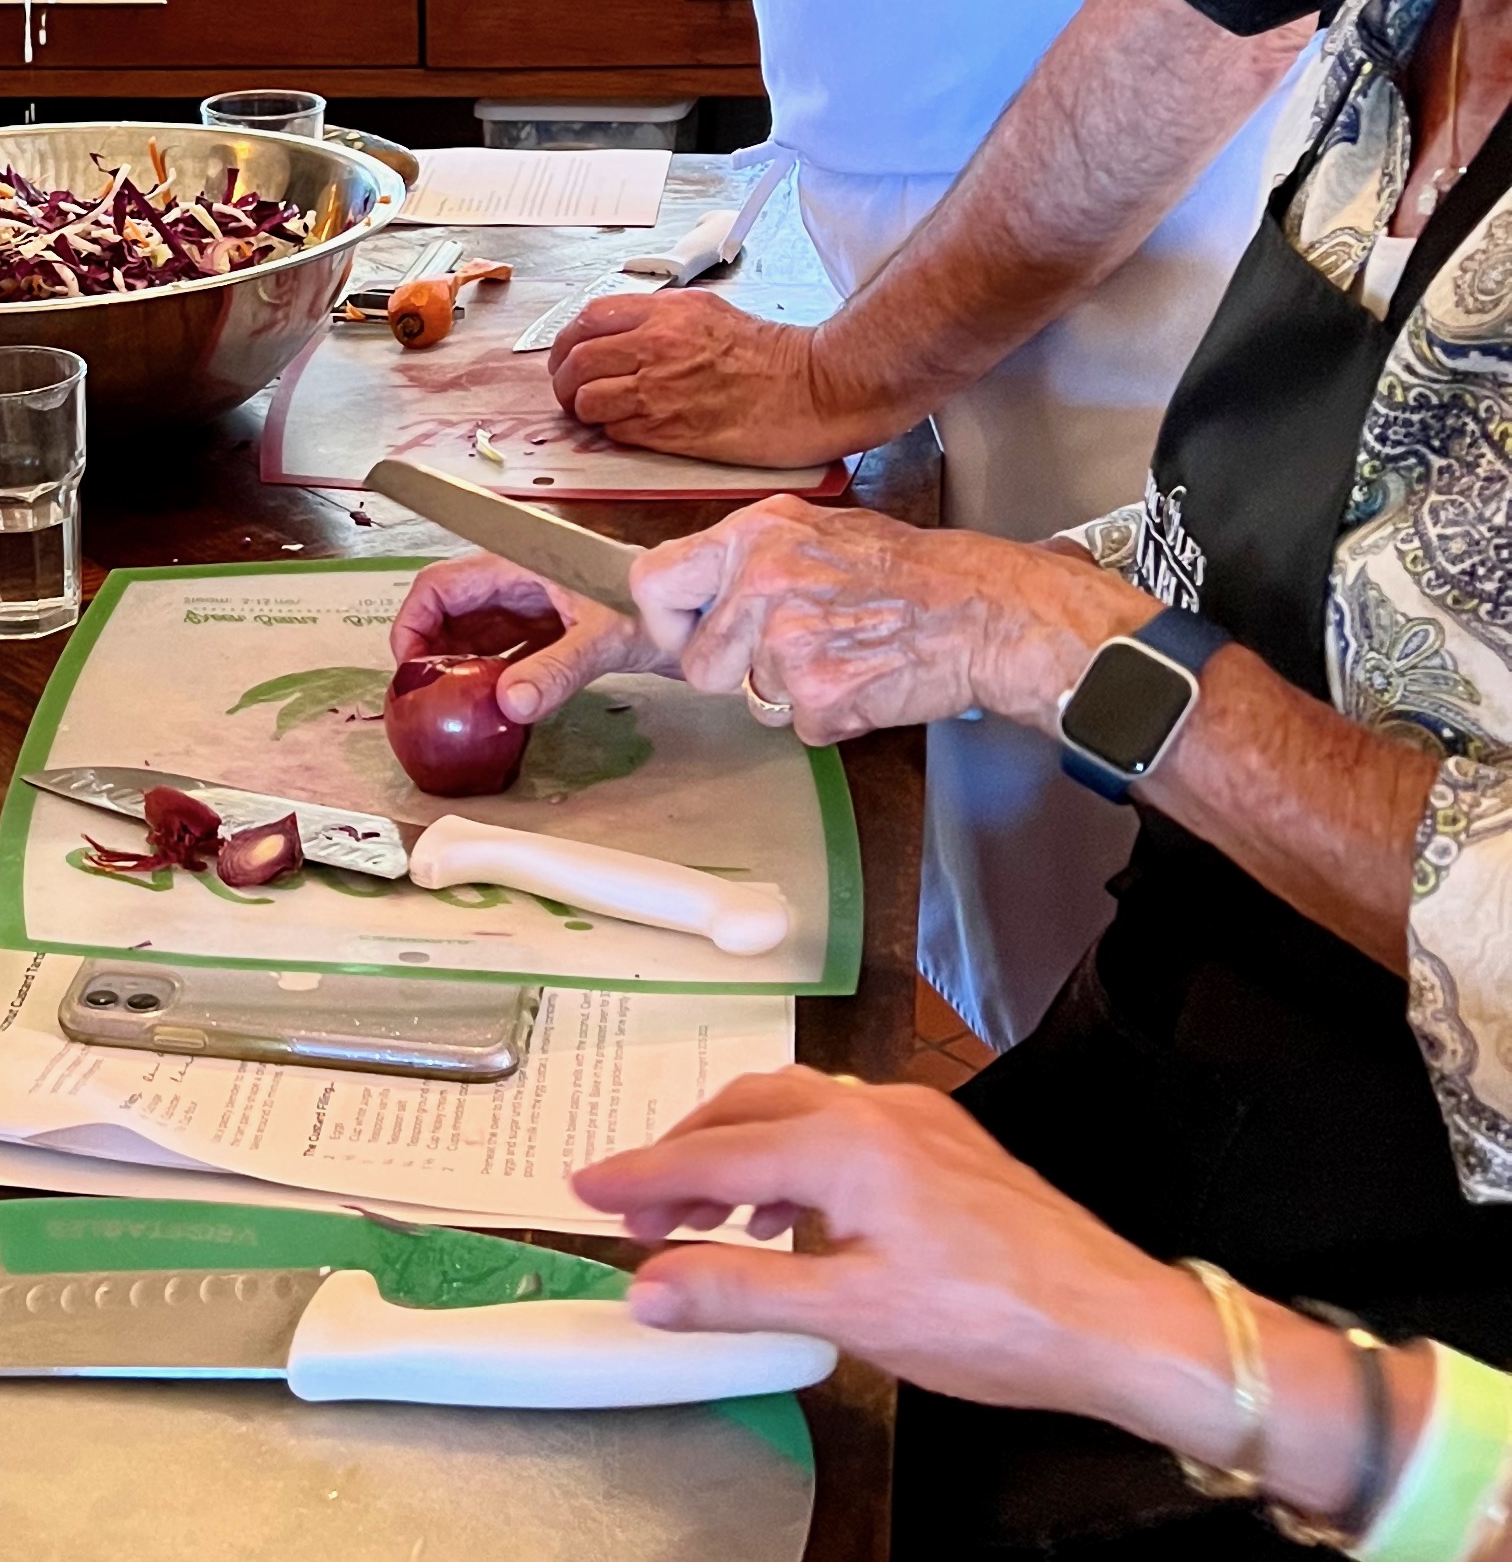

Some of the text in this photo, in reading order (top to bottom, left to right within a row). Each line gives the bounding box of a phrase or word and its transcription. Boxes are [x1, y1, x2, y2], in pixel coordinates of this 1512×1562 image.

[6, 974, 38, 1008] Custard
[307, 1111, 326, 1142] Custard
[302, 1144, 317, 1157] The
